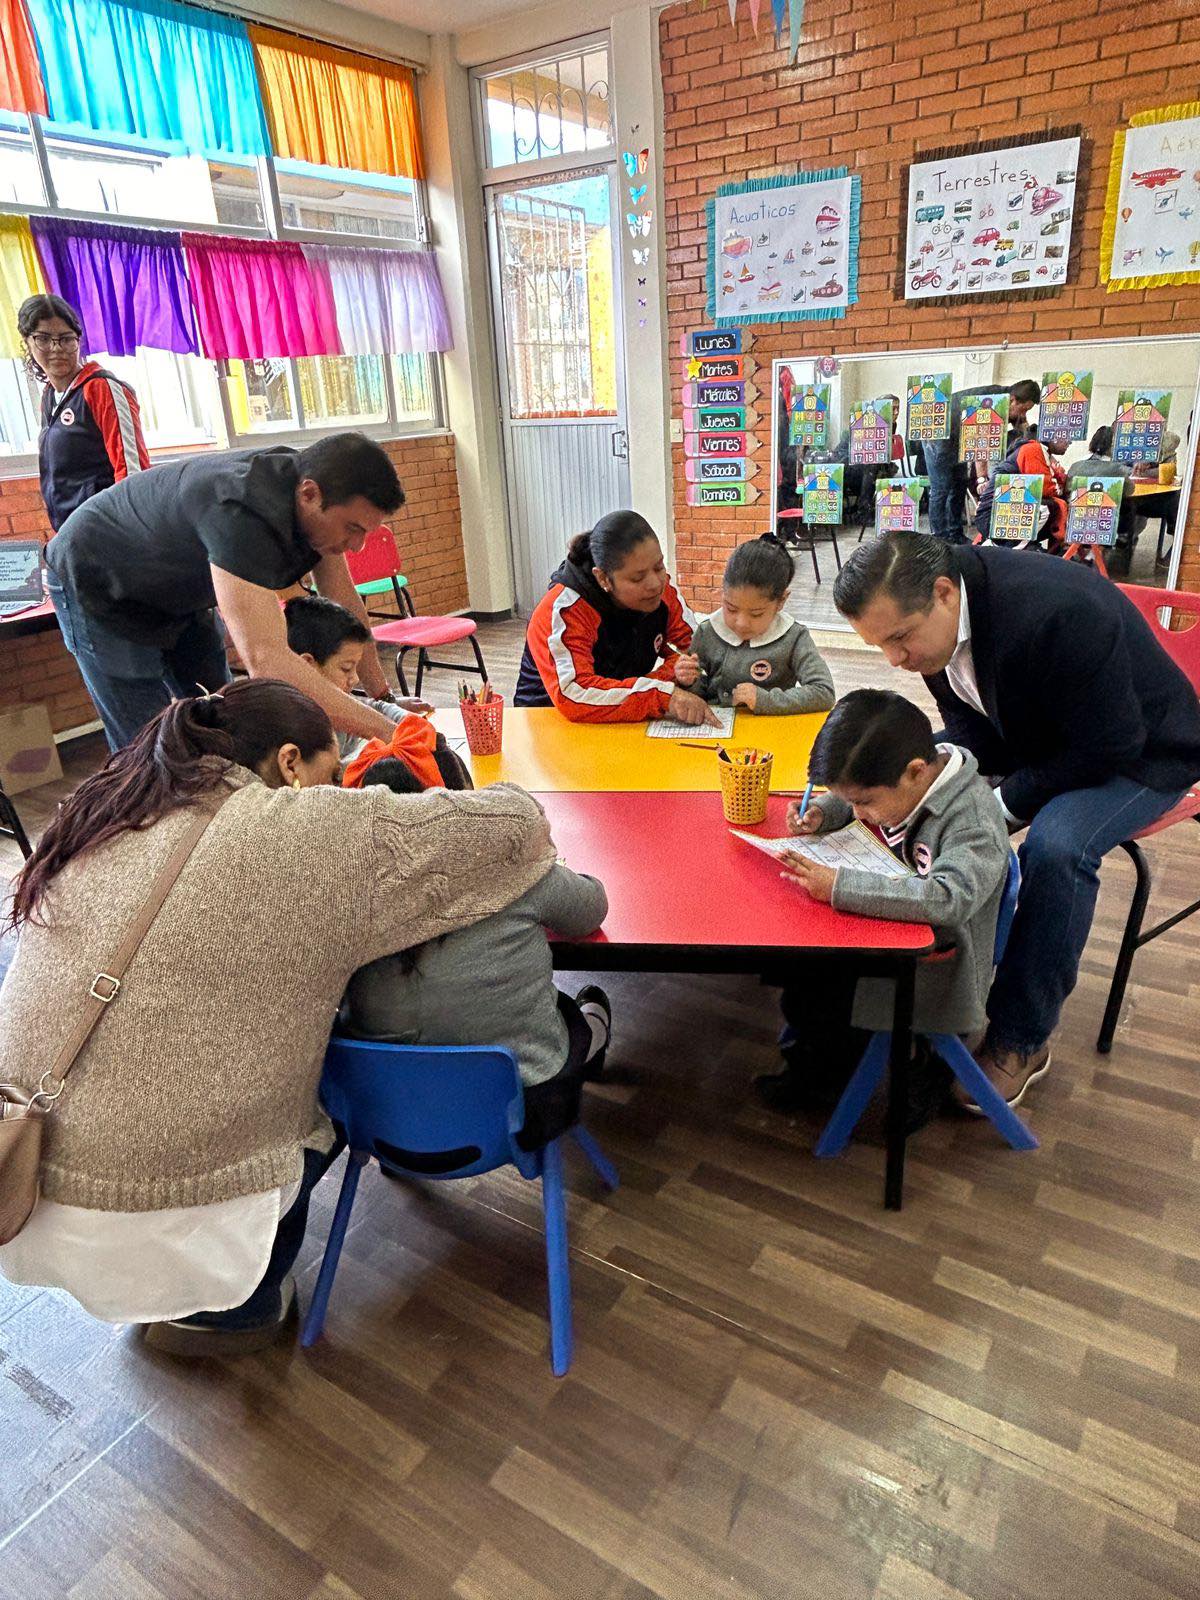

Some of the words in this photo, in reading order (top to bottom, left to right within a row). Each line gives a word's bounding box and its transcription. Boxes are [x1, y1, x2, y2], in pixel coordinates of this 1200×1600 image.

[730, 200, 797, 224] Acuaticos
[699, 337, 731, 350] Lunes
[702, 364, 733, 377] Martes
[1058, 387, 1073, 399] 40
[806, 397, 815, 409] 0
[1072, 403, 1083, 412] 43
[935, 404, 944, 413] 23
[818, 412, 823, 420] 3
[935, 416, 944, 425] 26
[1070, 416, 1082, 425] 46
[704, 416, 736, 427] Jueves
[817, 424, 823, 432] 6
[991, 425, 1000, 434] 33
[1149, 423, 1160, 433] 53
[865, 430, 875, 438] 12
[876, 430, 885, 438] 13
[922, 430, 932, 438] 28
[1044, 431, 1055, 439] 47
[1056, 431, 1067, 439] 48
[1070, 430, 1081, 439] 49
[796, 435, 802, 443] 7
[806, 436, 812, 444] 8
[817, 435, 822, 444] 9
[990, 438, 1000, 447] 36
[1147, 436, 1159, 446] 56
[703, 439, 740, 451] Viernes
[855, 442, 863, 450] 14
[865, 442, 874, 450] 15
[876, 441, 885, 450] 16
[854, 454, 863, 462] 17
[865, 453, 874, 462] 18
[876, 453, 885, 462] 19
[965, 453, 975, 461] 37
[977, 451, 987, 460] 38
[989, 451, 1000, 460] 39
[1118, 451, 1129, 459] 57
[1131, 451, 1143, 460] 58
[1145, 451, 1157, 460] 59
[705, 464, 736, 476] Sábado
[703, 489, 737, 502] Domingo
[828, 502, 837, 511] 66
[903, 506, 912, 515] 73
[1101, 508, 1112, 517] 93
[903, 518, 912, 526] 76
[1021, 516, 1032, 525] 86
[1099, 521, 1111, 530] 96
[996, 528, 1006, 537] 87
[1008, 529, 1018, 537] 88
[1072, 533, 1084, 542] 97
[1085, 533, 1096, 542] 98
[1098, 534, 1110, 542] 99
